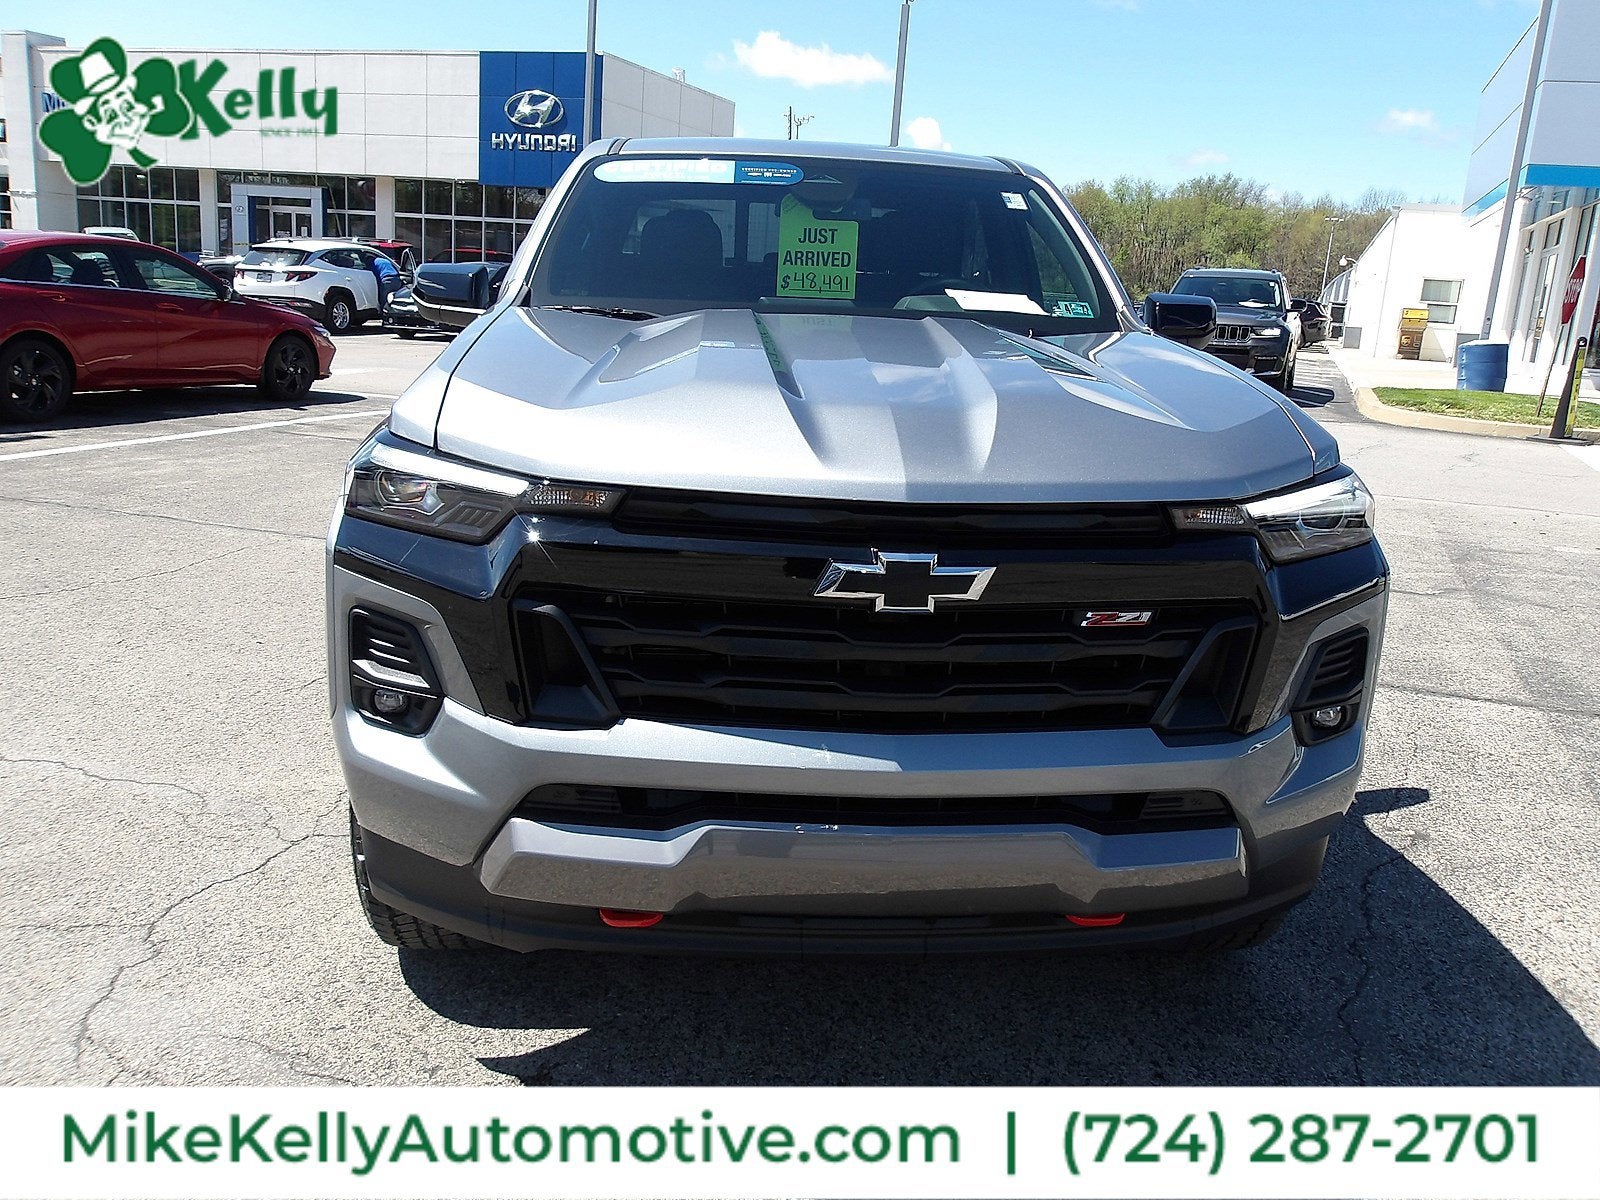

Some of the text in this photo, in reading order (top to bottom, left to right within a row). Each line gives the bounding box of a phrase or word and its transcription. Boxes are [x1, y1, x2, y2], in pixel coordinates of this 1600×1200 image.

[491, 132, 577, 152] HYUNDAI
[798, 227, 838, 244] JUST
[783, 250, 851, 267] ARRIVED
[781, 271, 849, 293] $48,491
[1080, 611, 1152, 627] Z71
